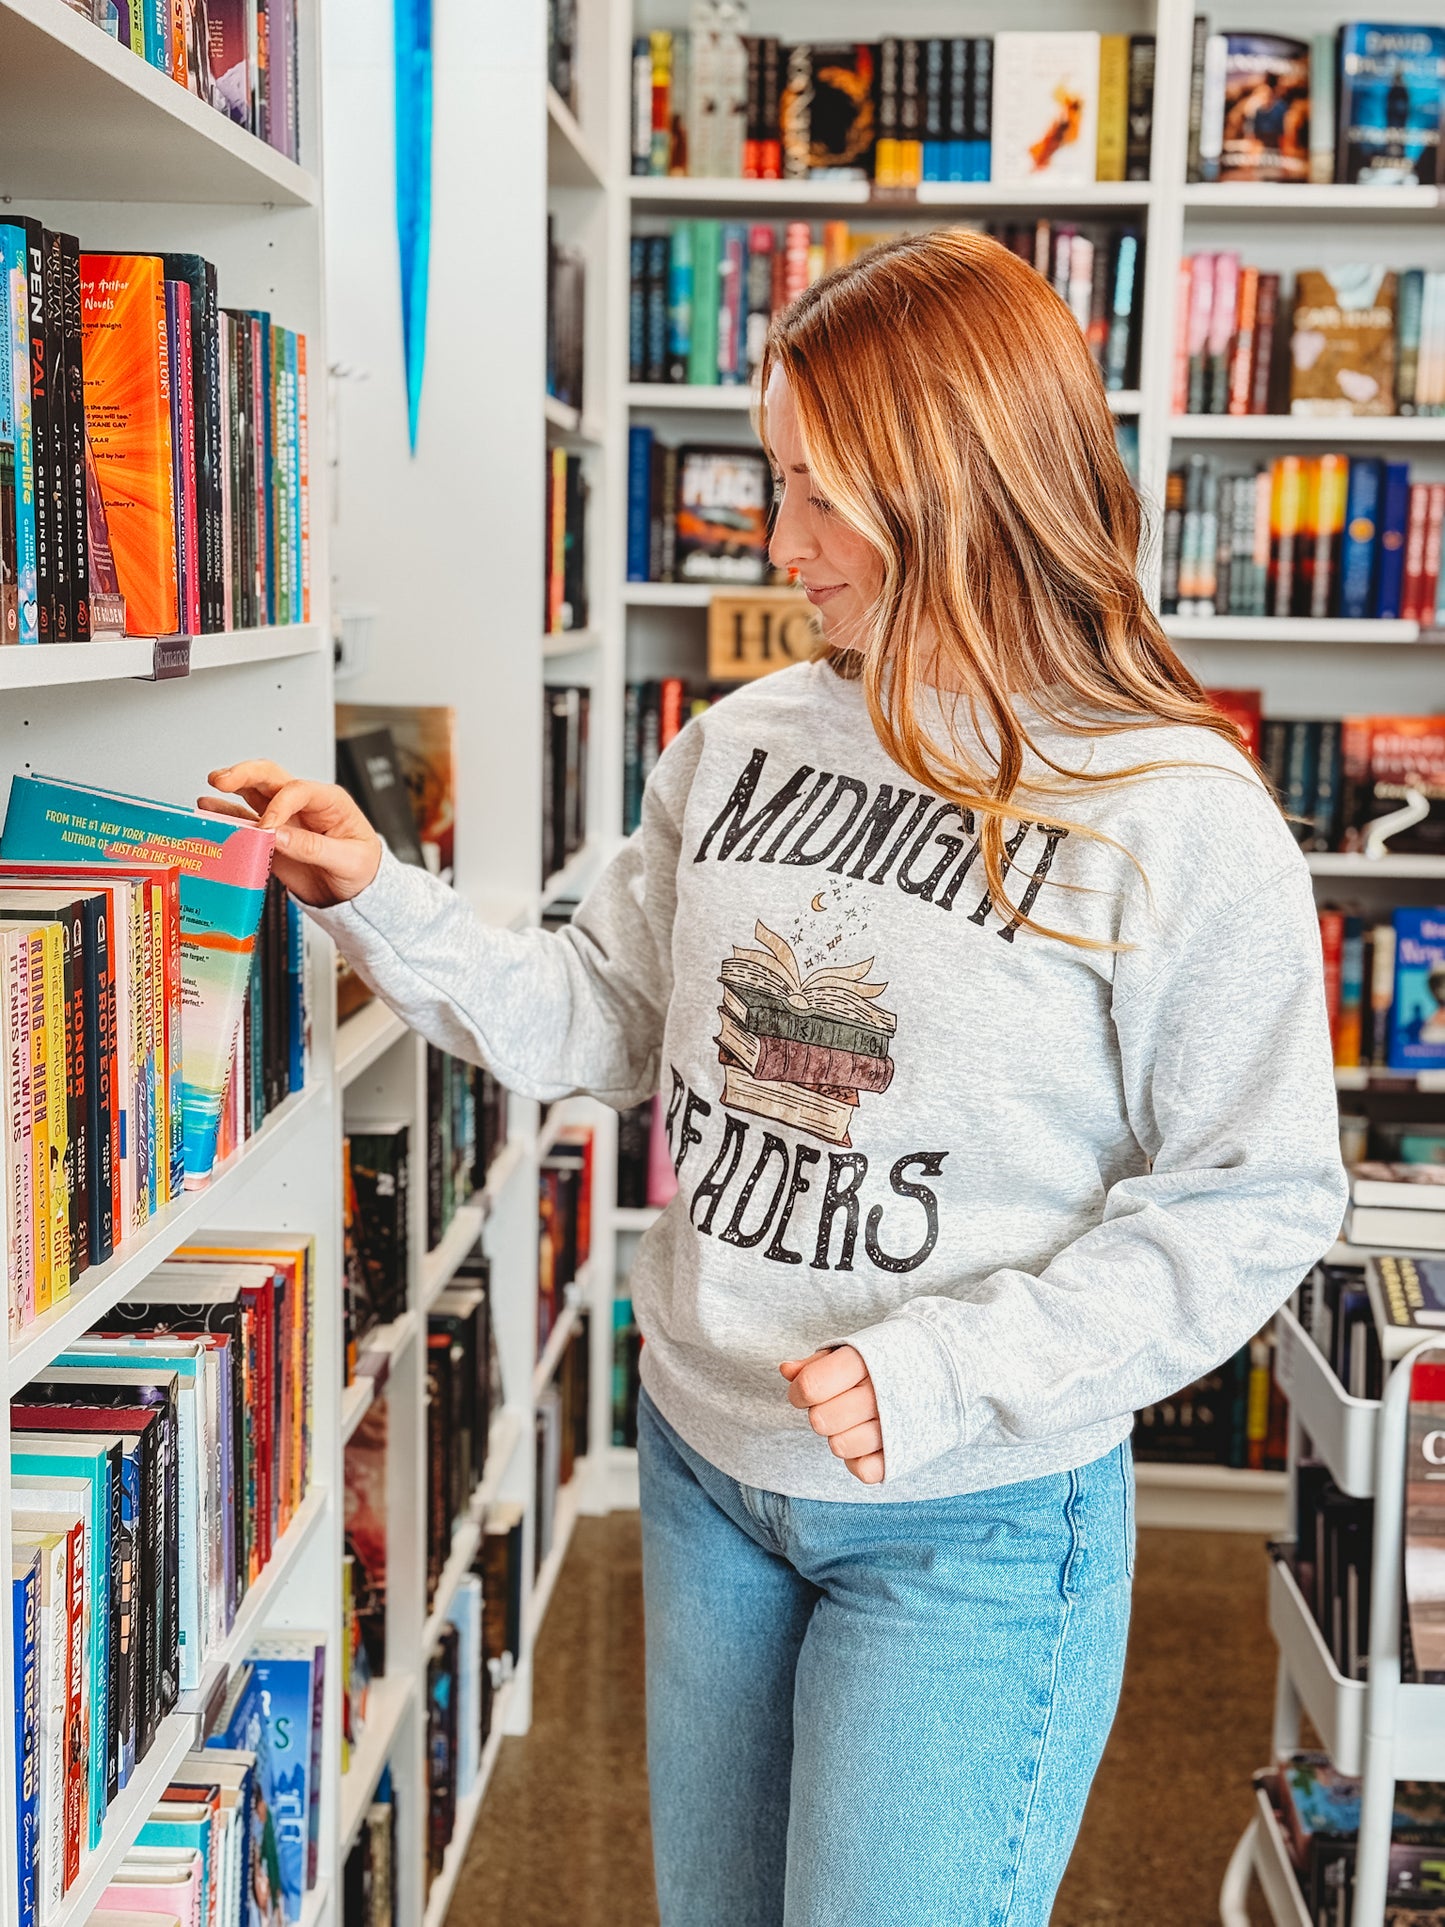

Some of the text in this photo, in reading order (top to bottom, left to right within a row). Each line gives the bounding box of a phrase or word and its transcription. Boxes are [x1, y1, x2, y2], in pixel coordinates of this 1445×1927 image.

[30, 247, 45, 400] PEN PAL
[46, 255, 54, 319] VOWS
[52, 246, 62, 332] BRUTAL
[63, 254, 74, 338] HEARTS
[81, 279, 129, 294] ing Author
[85, 298, 115, 311] Novels
[38, 465, 47, 579] GEISSINGER
[55, 464, 64, 584] GEISSINGER
[73, 423, 85, 580] J.T. GEISSINGER
[156, 646, 189, 670] Romance
[46, 809, 223, 860] FROM THE #1 NEW YORK TIMES BESTSELLING
[61, 830, 203, 872] AUTHOR OF JUST FOR THE SUMMER
[693, 748, 1069, 944] MIDNIGHT
[30, 940, 45, 1031] RIDING
[144, 976, 152, 1048] HUNTING
[154, 936, 163, 1048] COMPLICATED
[10, 953, 22, 1142] IT ENDS WITH US
[52, 966, 61, 1138] HELENA HUNTING
[74, 988, 85, 1098] HONOR
[99, 970, 109, 1112] PROTECT
[34, 1062, 47, 1124] HIGH
[53, 1230, 62, 1272] CUTE
[62, 1224, 70, 1267] MEET
[25, 1579, 35, 1649] FOR
[71, 1529, 84, 1699] DEJA BREW
[23, 1667, 34, 1802] RECORD
[23, 1813, 32, 1915] Emma Lord
[52, 1815, 60, 1877] MANN
